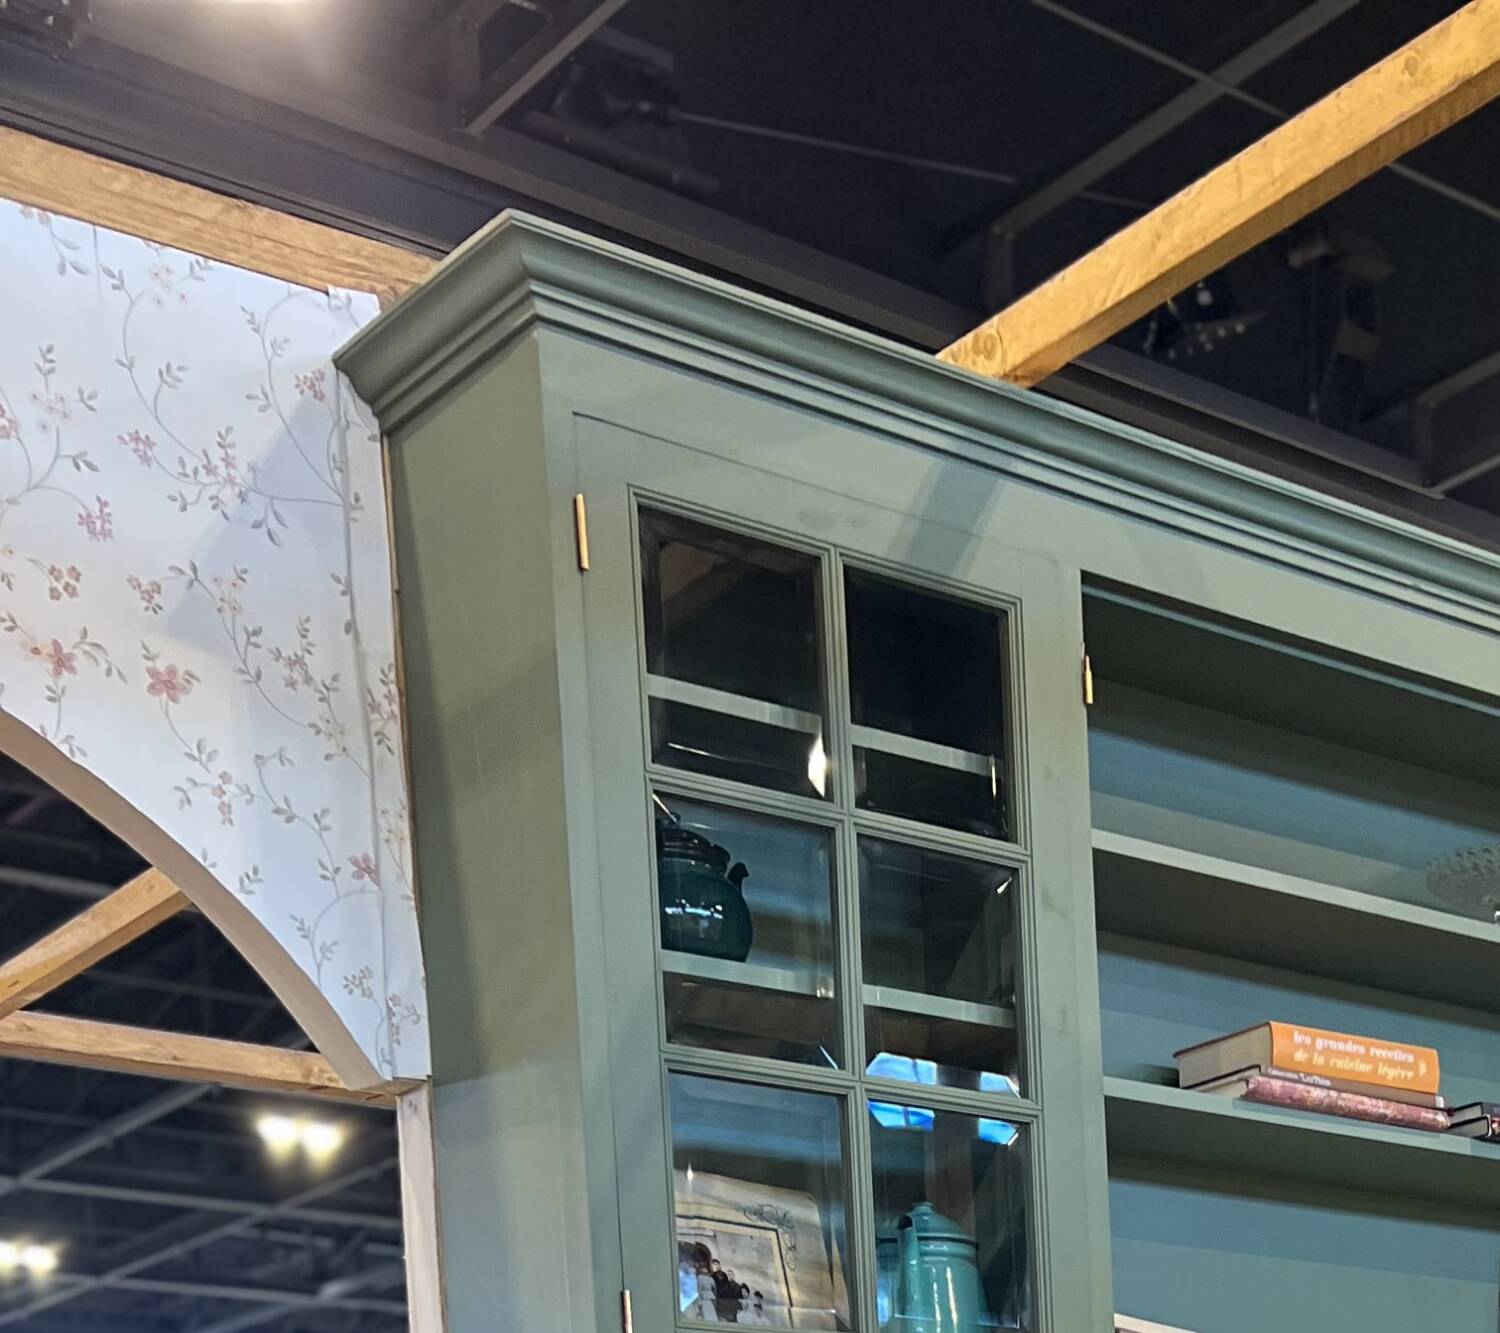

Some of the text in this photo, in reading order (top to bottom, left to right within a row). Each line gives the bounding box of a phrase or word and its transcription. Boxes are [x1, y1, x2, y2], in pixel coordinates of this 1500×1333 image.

[1293, 1030, 1414, 1062] les grandes recettes
[1294, 1048, 1309, 1063] de
[1312, 1052, 1326, 1066] la
[1330, 1058, 1374, 1073] cuisine
